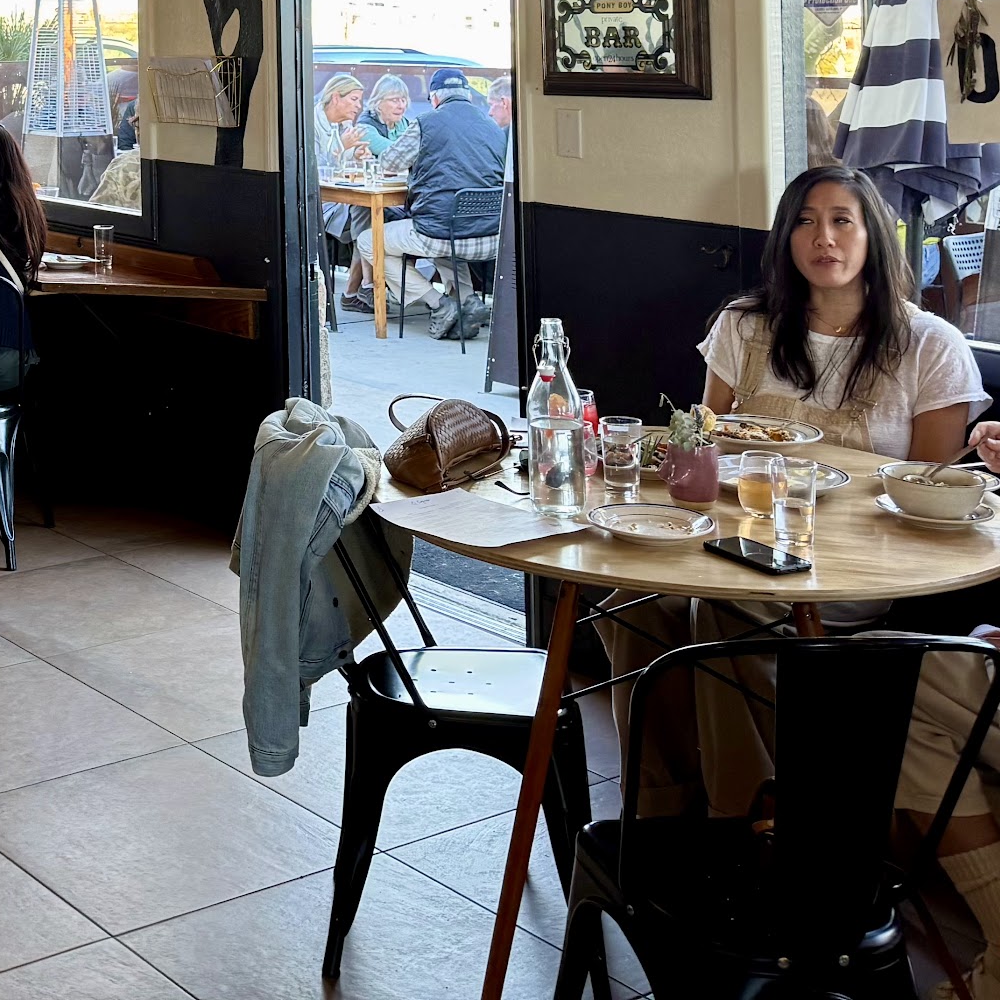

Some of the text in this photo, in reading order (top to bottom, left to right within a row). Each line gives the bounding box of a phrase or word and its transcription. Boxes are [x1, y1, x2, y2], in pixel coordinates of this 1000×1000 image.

[618, 1, 632, 9] BOY
[584, 26, 642, 48] BAR
[616, 54, 634, 62] hours
